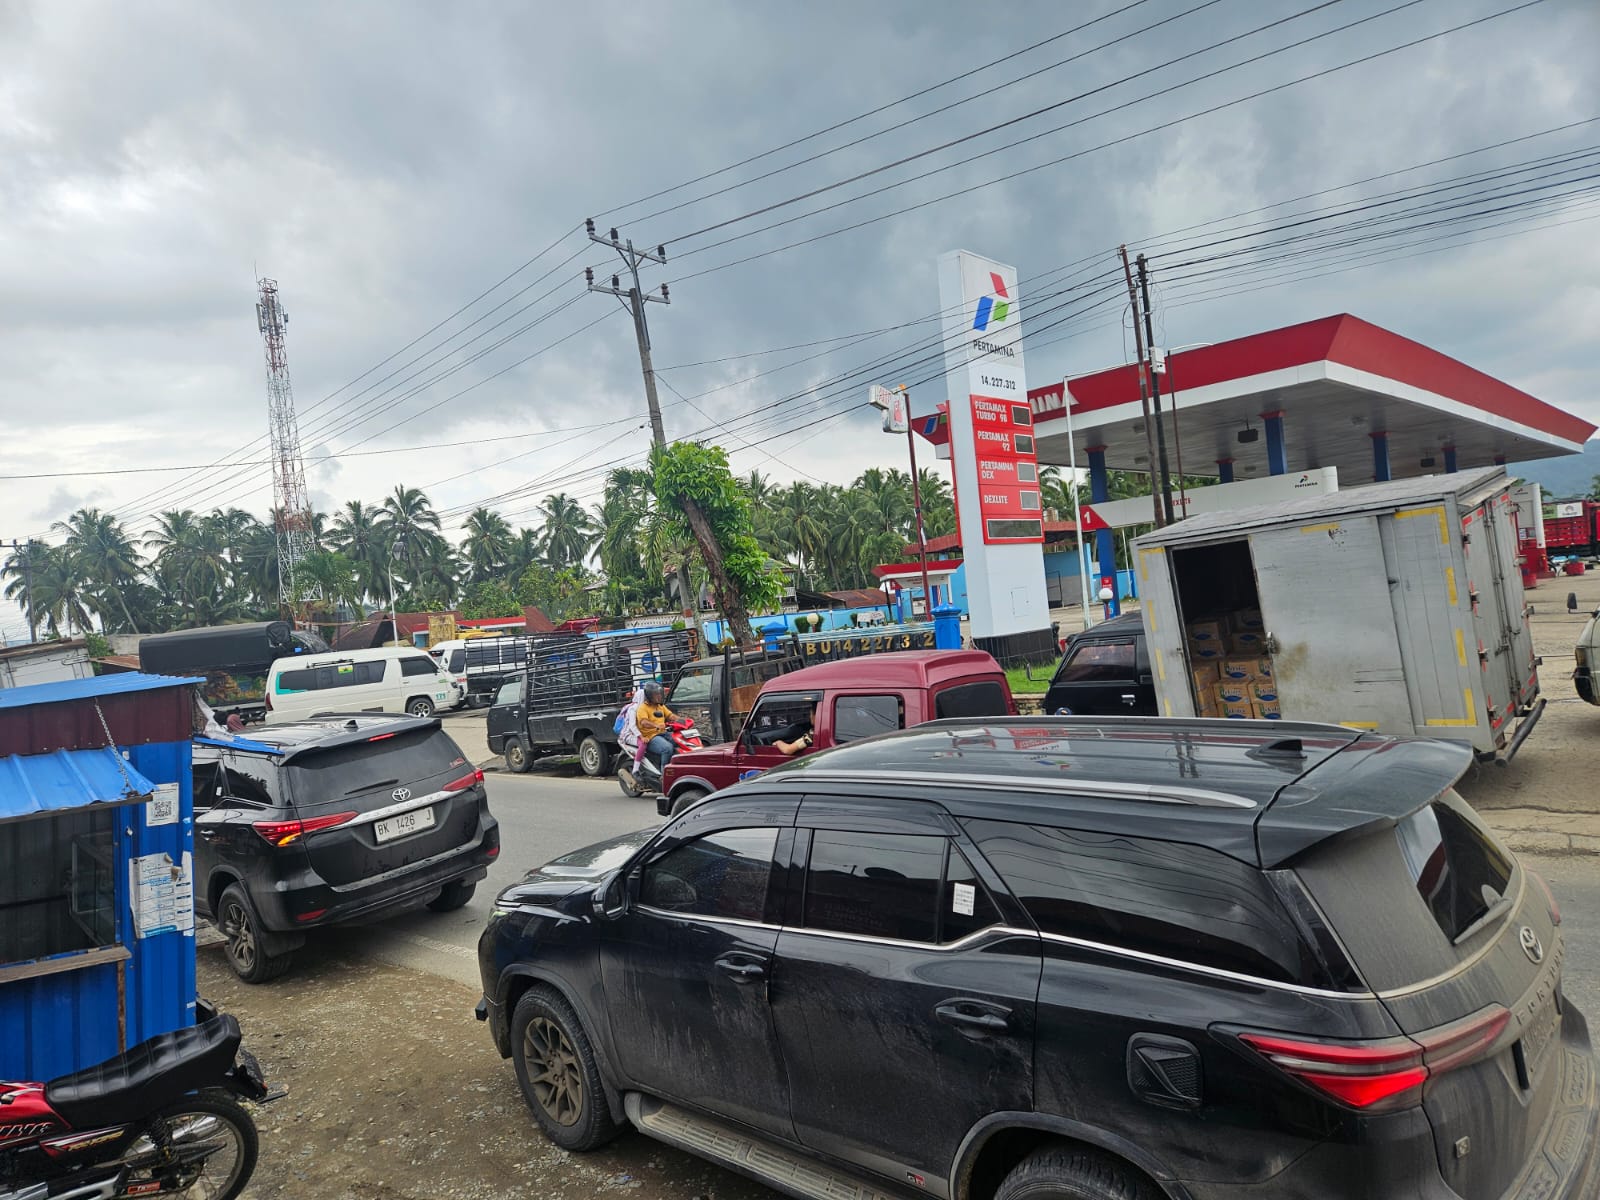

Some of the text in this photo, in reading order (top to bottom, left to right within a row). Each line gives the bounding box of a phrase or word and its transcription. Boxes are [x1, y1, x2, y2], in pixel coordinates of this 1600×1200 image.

[973, 340, 1015, 358] PERTAMINA
[981, 375, 1016, 390] 14.227.312
[975, 401, 1007, 413] PERTAMAX
[976, 410, 1008, 423] TURBO 98
[977, 430, 1009, 442] PERTAMAX
[1002, 442, 1011, 452] 92
[980, 460, 1014, 472] PERTAMINA
[982, 471, 995, 480] DEX
[984, 494, 1009, 504] DEXLITE
[1084, 511, 1091, 524] 1
[377, 821, 390, 836] BK
[396, 815, 416, 830] 1426
[426, 809, 432, 821] J
